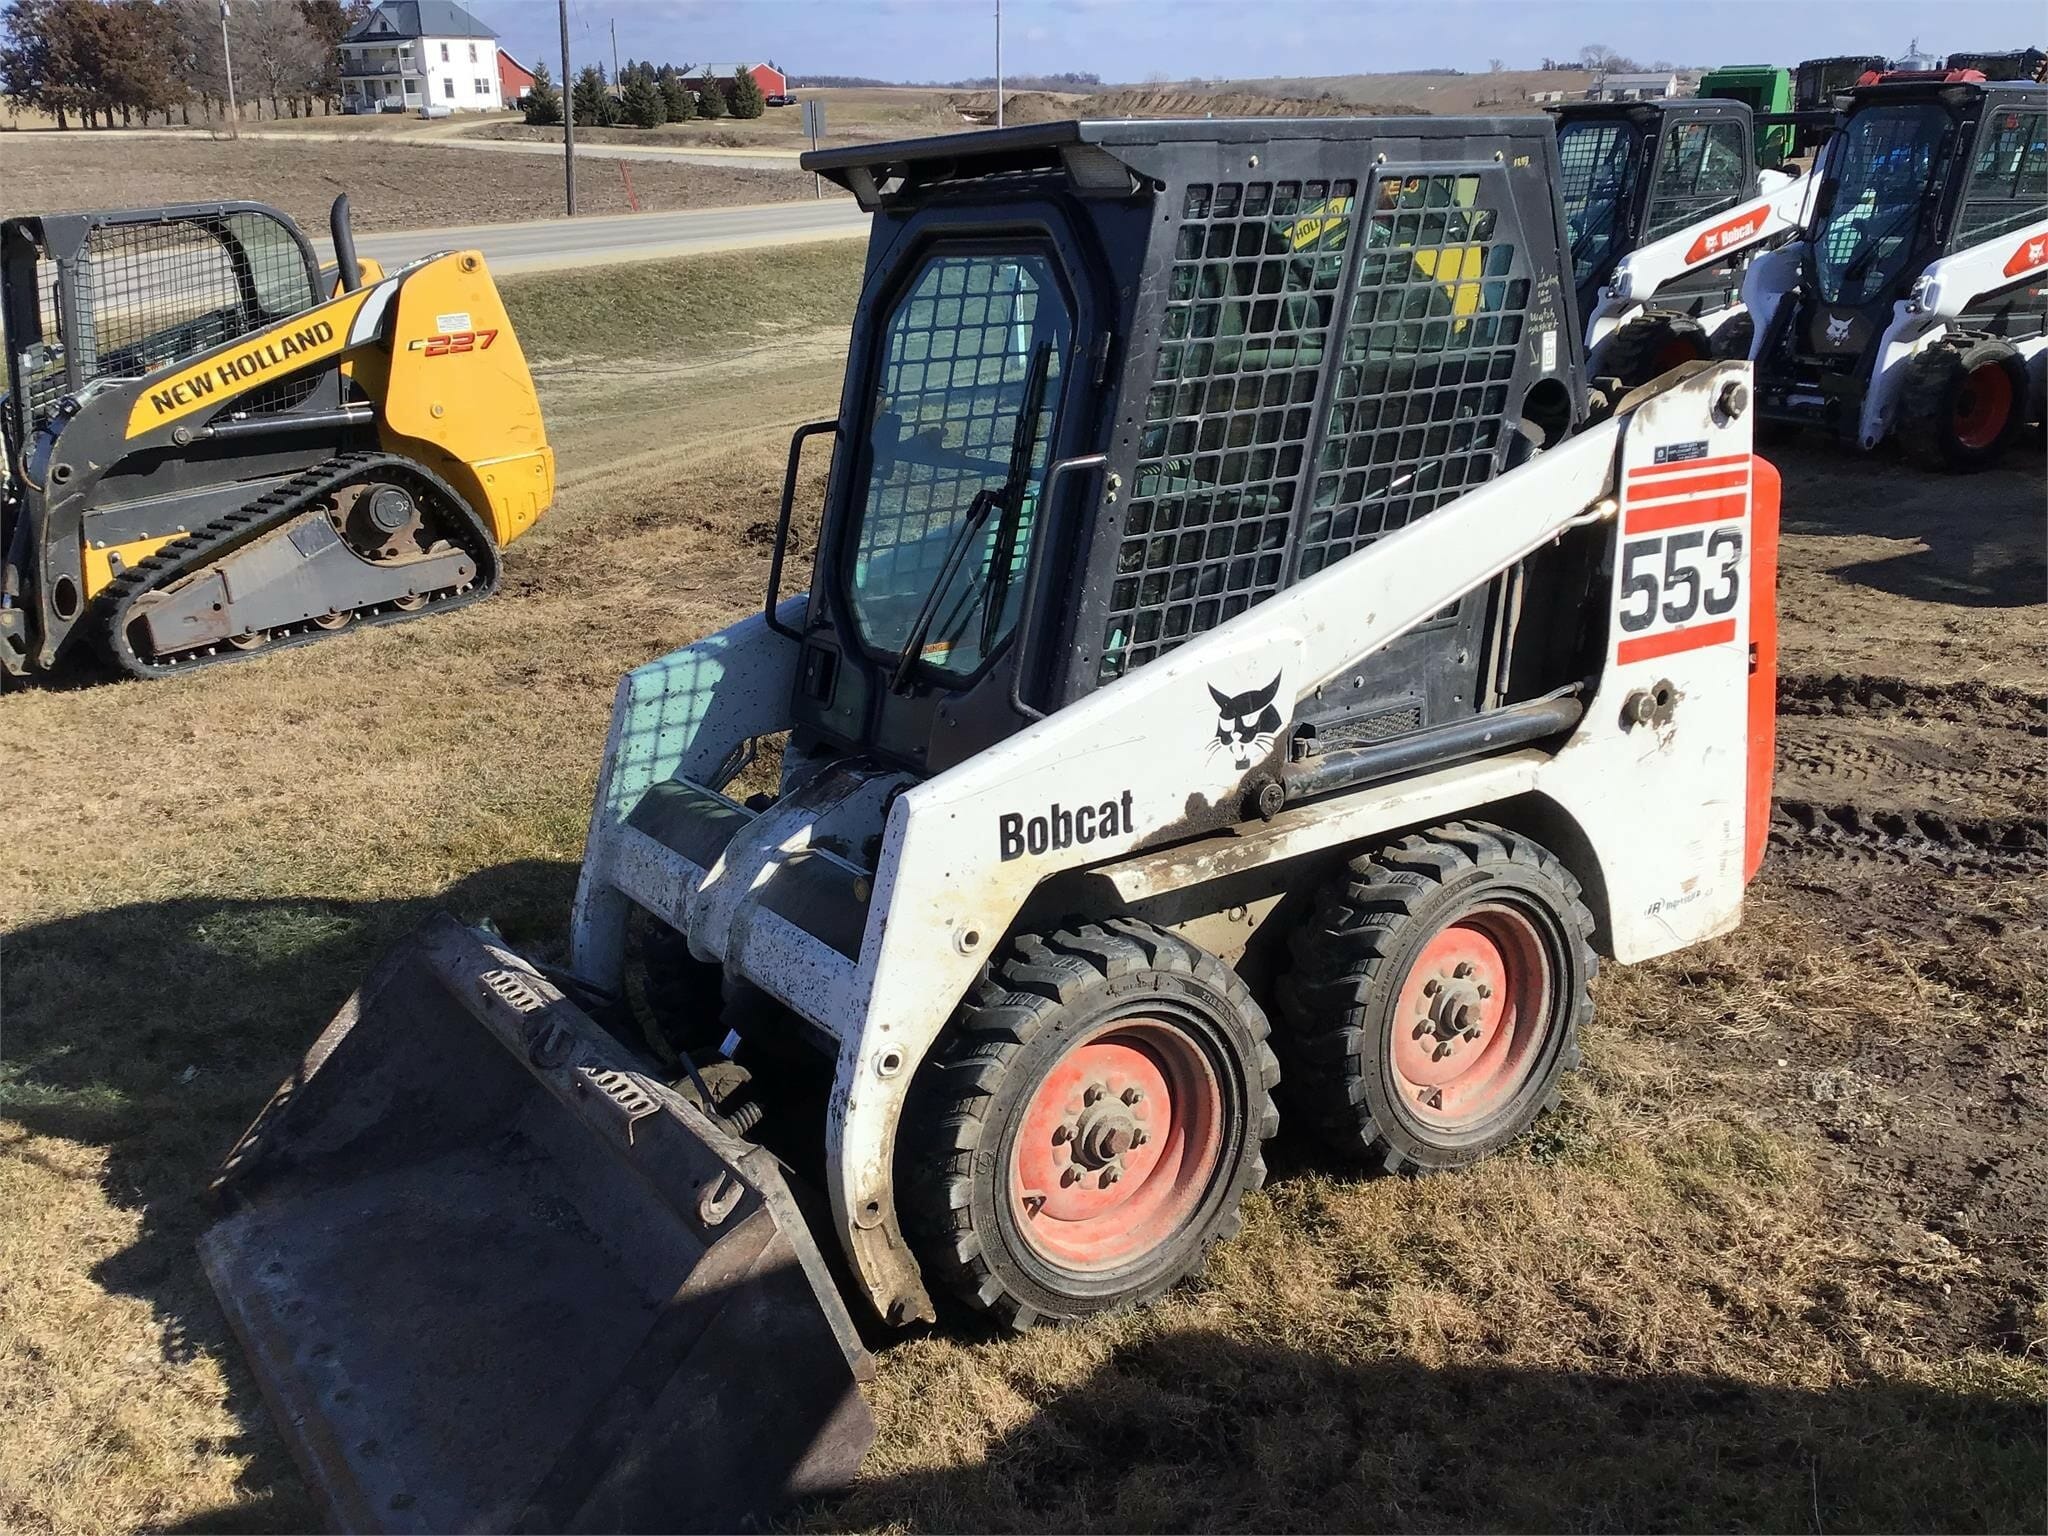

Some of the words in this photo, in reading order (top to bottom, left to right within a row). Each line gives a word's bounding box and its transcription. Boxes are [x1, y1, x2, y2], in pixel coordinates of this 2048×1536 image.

[1721, 220, 1754, 247] Bobcat
[150, 371, 214, 415] NEW
[216, 320, 334, 386] HOLLAND
[408, 329, 498, 357] C227
[1619, 526, 1743, 633] 553
[1000, 790, 1133, 862] Bobcat
